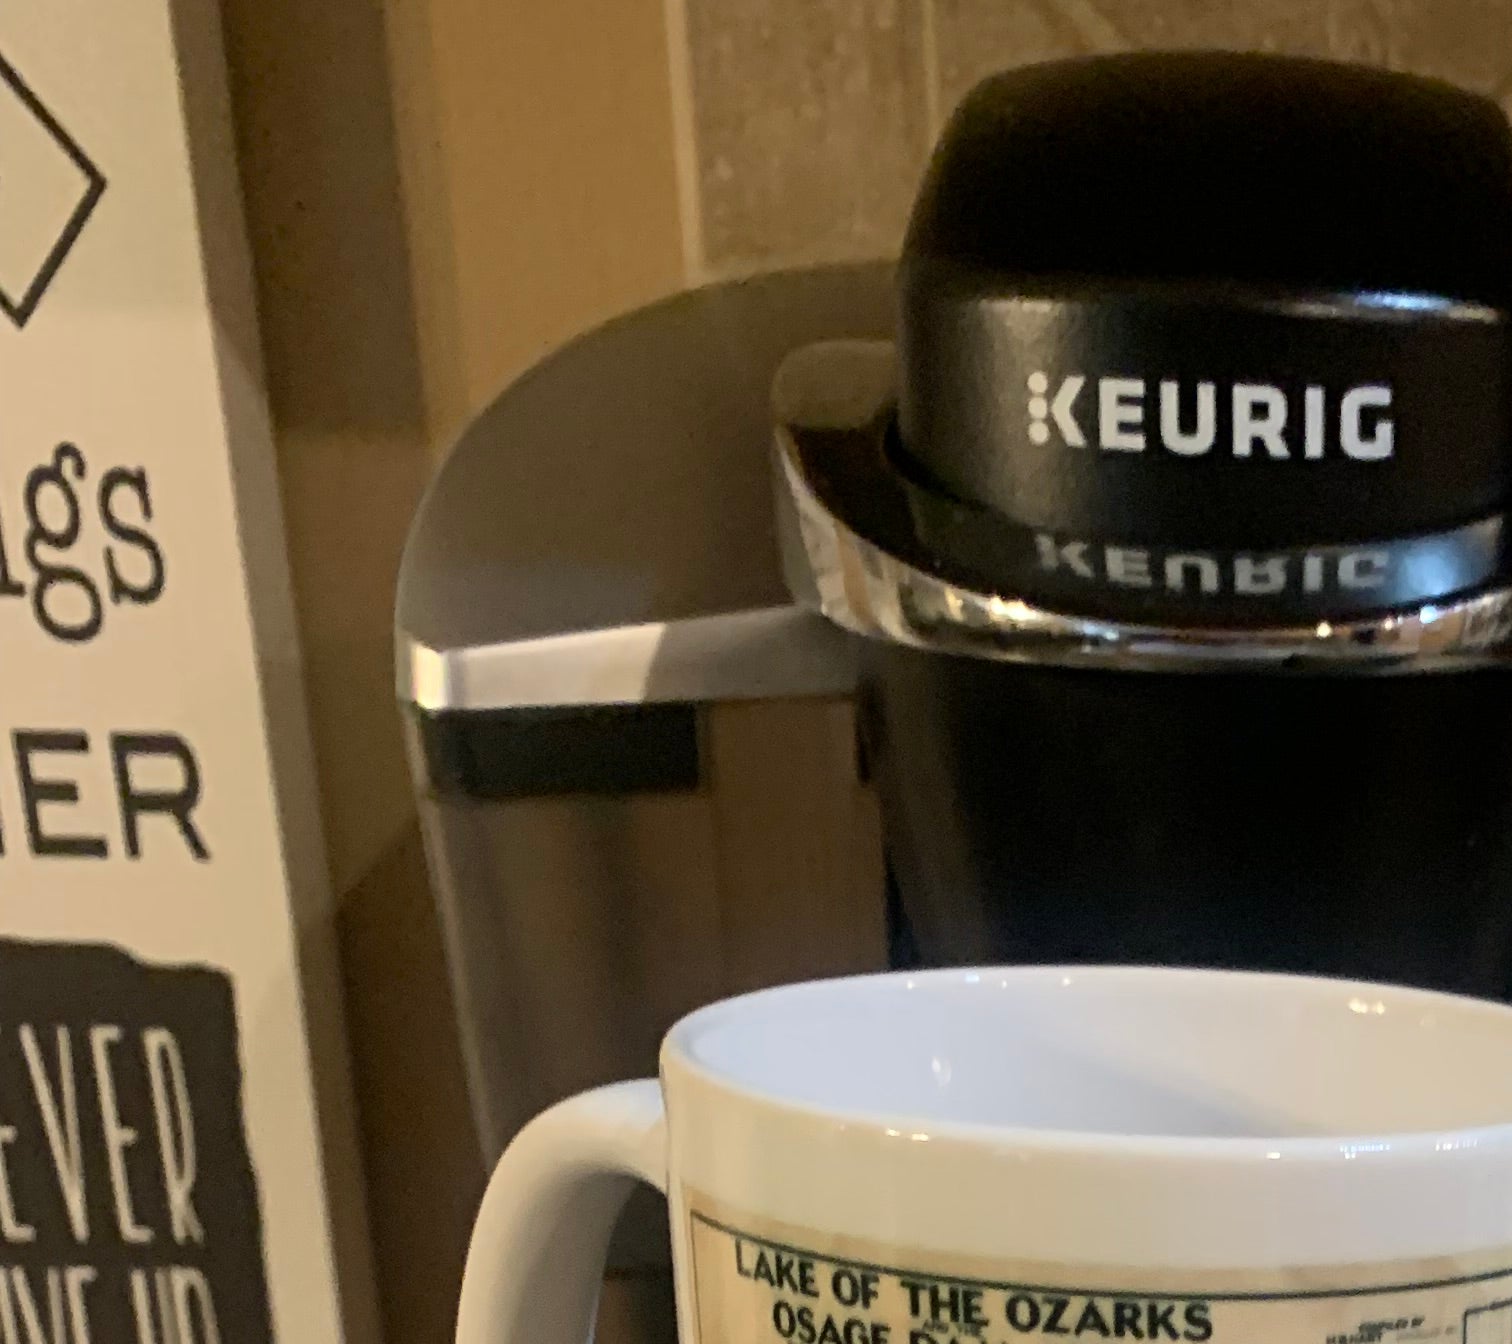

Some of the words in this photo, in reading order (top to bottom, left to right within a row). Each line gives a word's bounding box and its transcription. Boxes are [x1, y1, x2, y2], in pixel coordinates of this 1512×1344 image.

[1027, 371, 1395, 462] KEURIG
[0, 441, 166, 644] gs
[0, 729, 211, 863] ER
[735, 1240, 819, 1299] LAKE
[832, 1269, 880, 1309] OF
[901, 1281, 990, 1327] THE
[1005, 1293, 1214, 1343] OZARKS
